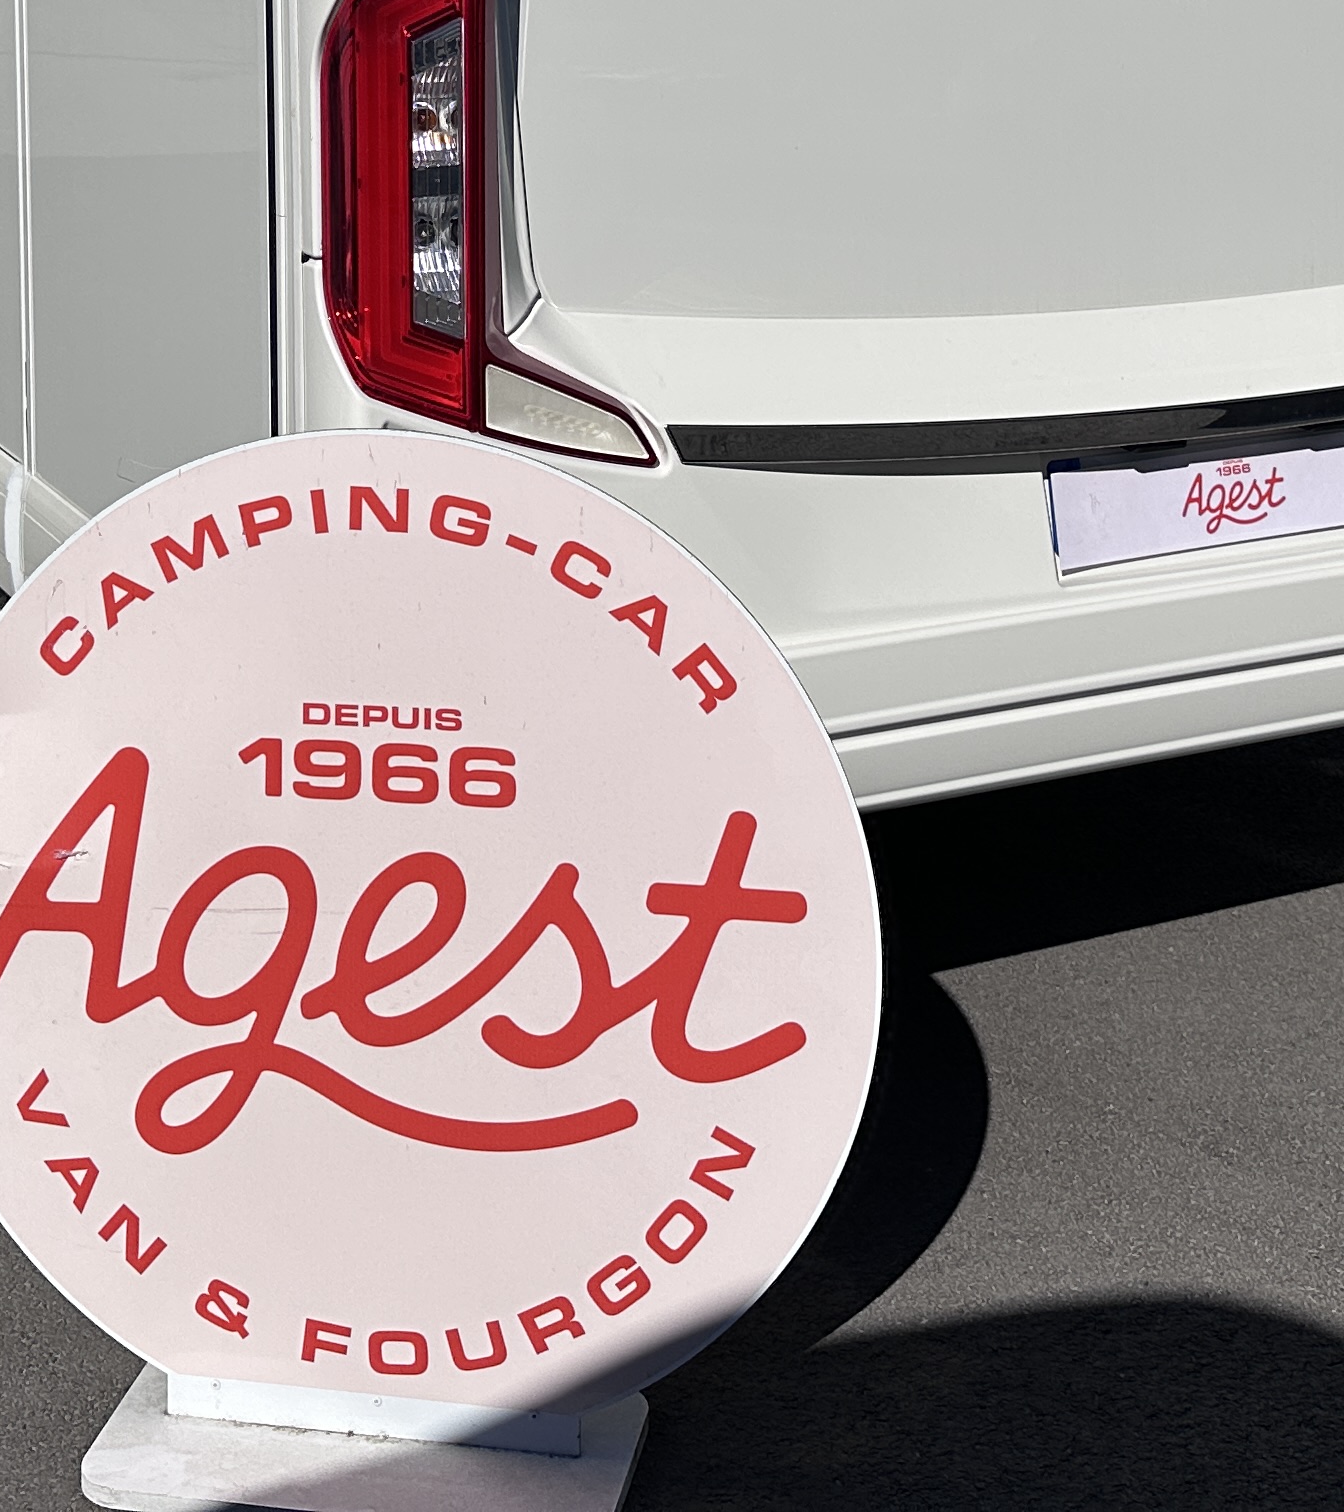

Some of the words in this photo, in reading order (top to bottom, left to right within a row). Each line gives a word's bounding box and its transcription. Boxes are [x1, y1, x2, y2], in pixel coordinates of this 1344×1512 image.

[1182, 467, 1286, 534] Agest
[40, 485, 739, 714] CAMPING-CAR
[302, 702, 464, 732] DEPUIS
[238, 737, 517, 808] 1966
[16, 1069, 168, 1275] VAN
[194, 1279, 250, 1339] &
[301, 1125, 756, 1376] FOURGON
